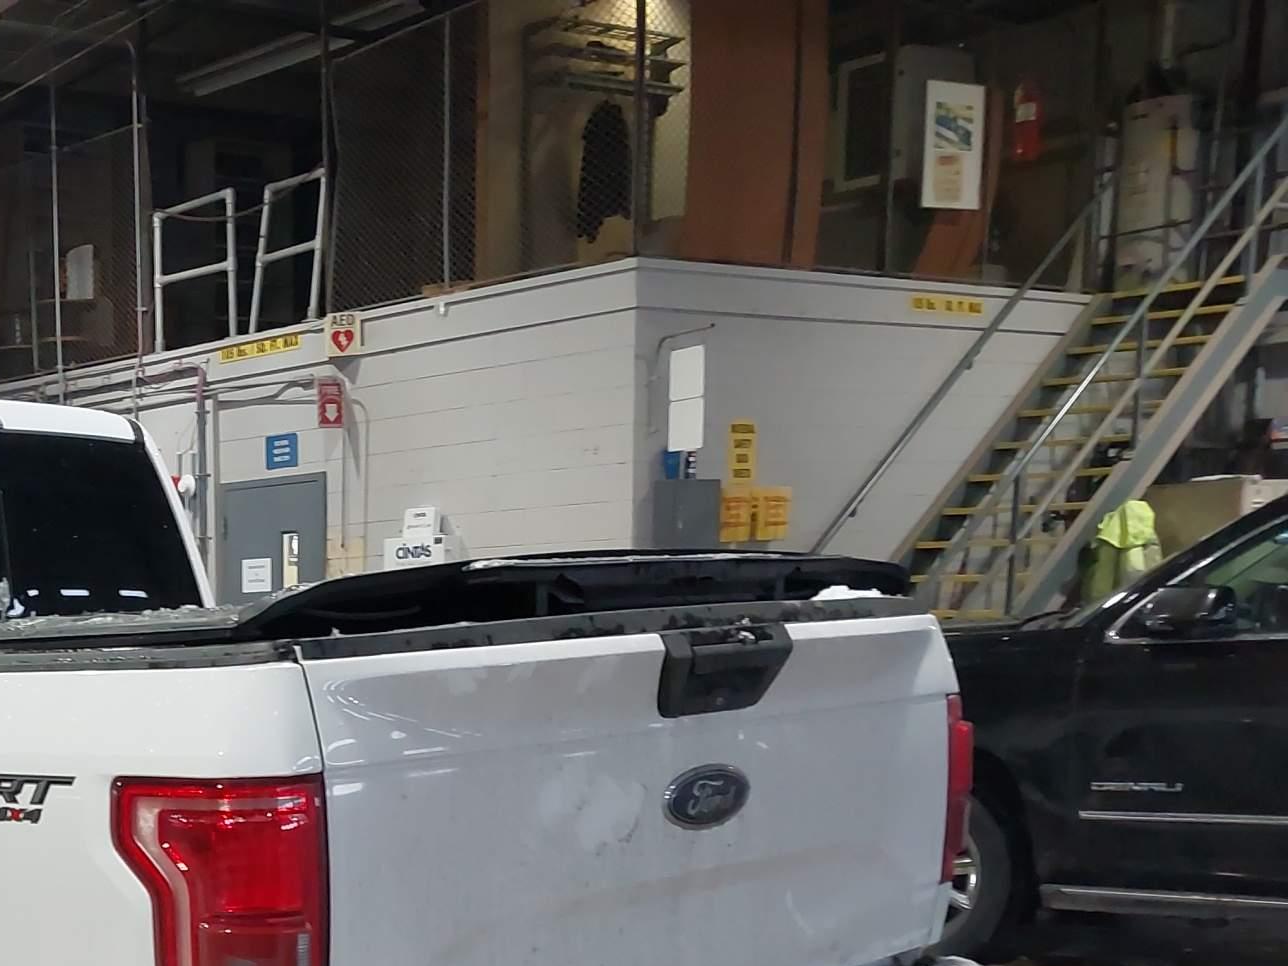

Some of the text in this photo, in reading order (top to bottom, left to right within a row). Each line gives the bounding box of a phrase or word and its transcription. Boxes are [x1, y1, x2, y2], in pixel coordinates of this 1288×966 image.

[331, 314, 355, 327] AED
[395, 543, 433, 560] CINTAS
[687, 779, 737, 817] Ford
